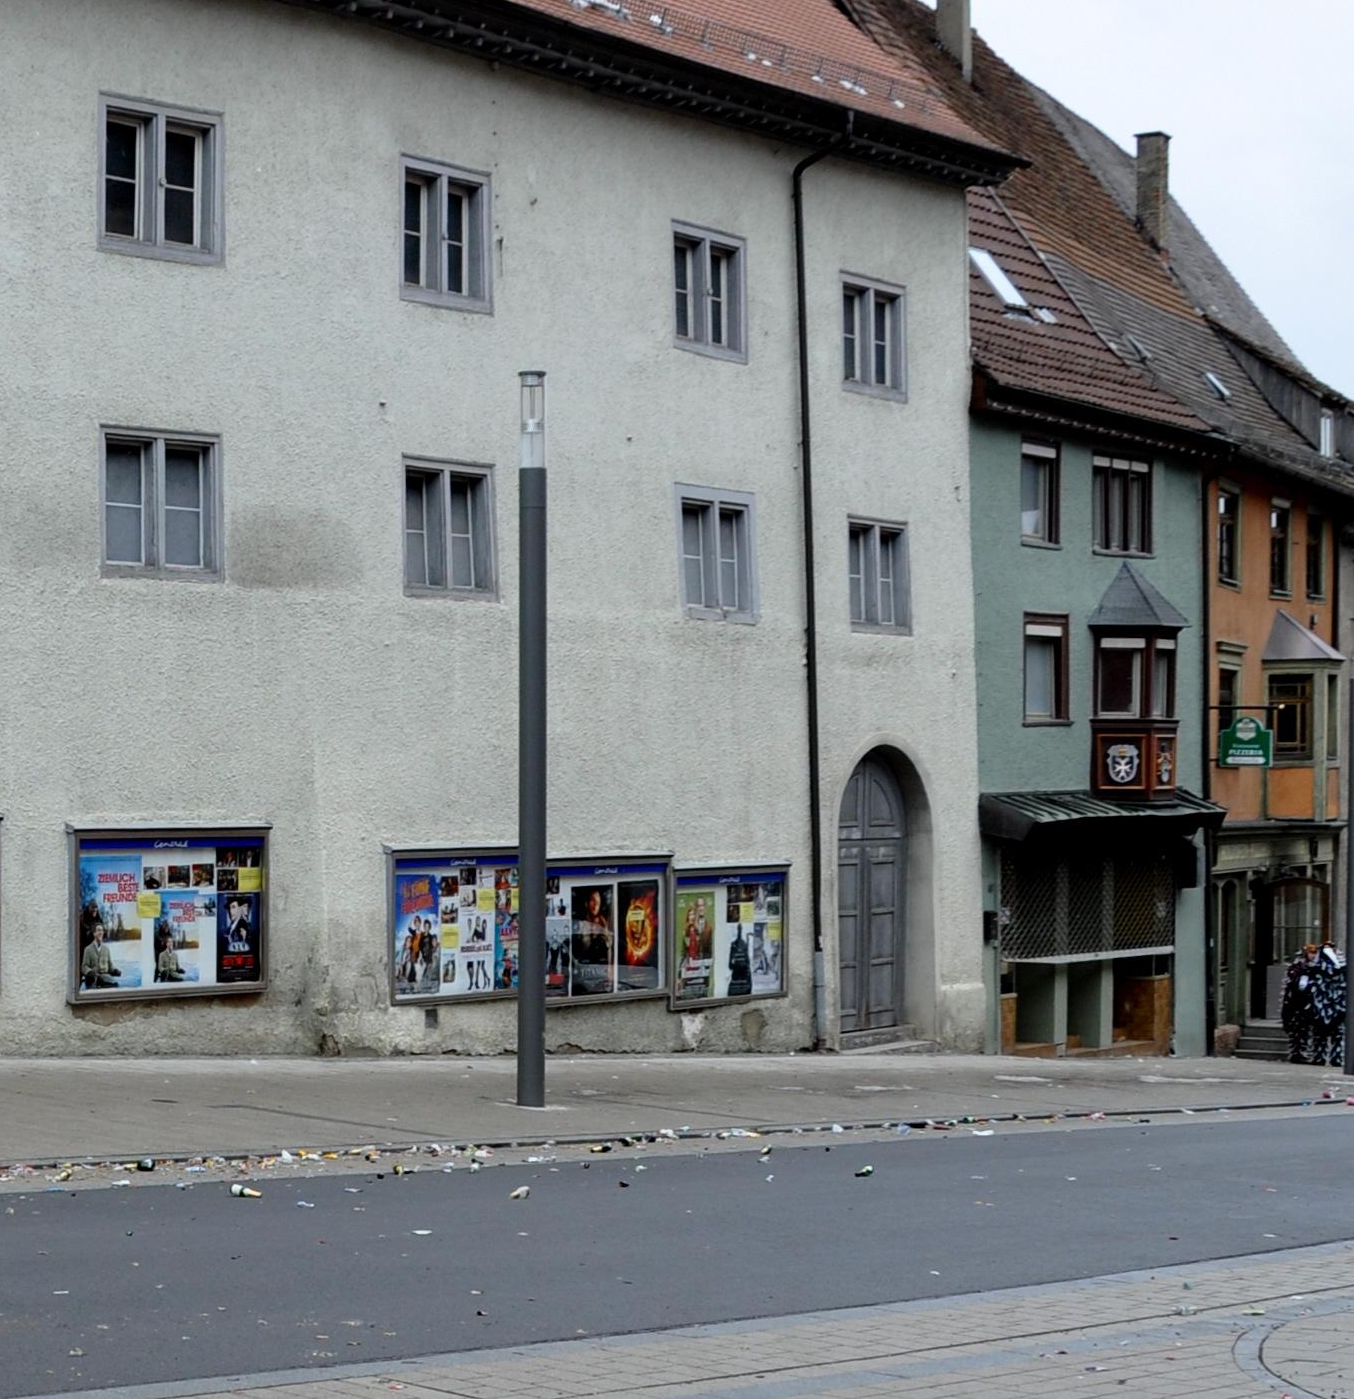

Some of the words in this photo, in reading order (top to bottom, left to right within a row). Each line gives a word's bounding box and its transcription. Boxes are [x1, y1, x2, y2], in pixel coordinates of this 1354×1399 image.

[153, 840, 188, 849] Central
[98, 873, 136, 883] ZIEMLICH
[118, 882, 139, 892] BESTE
